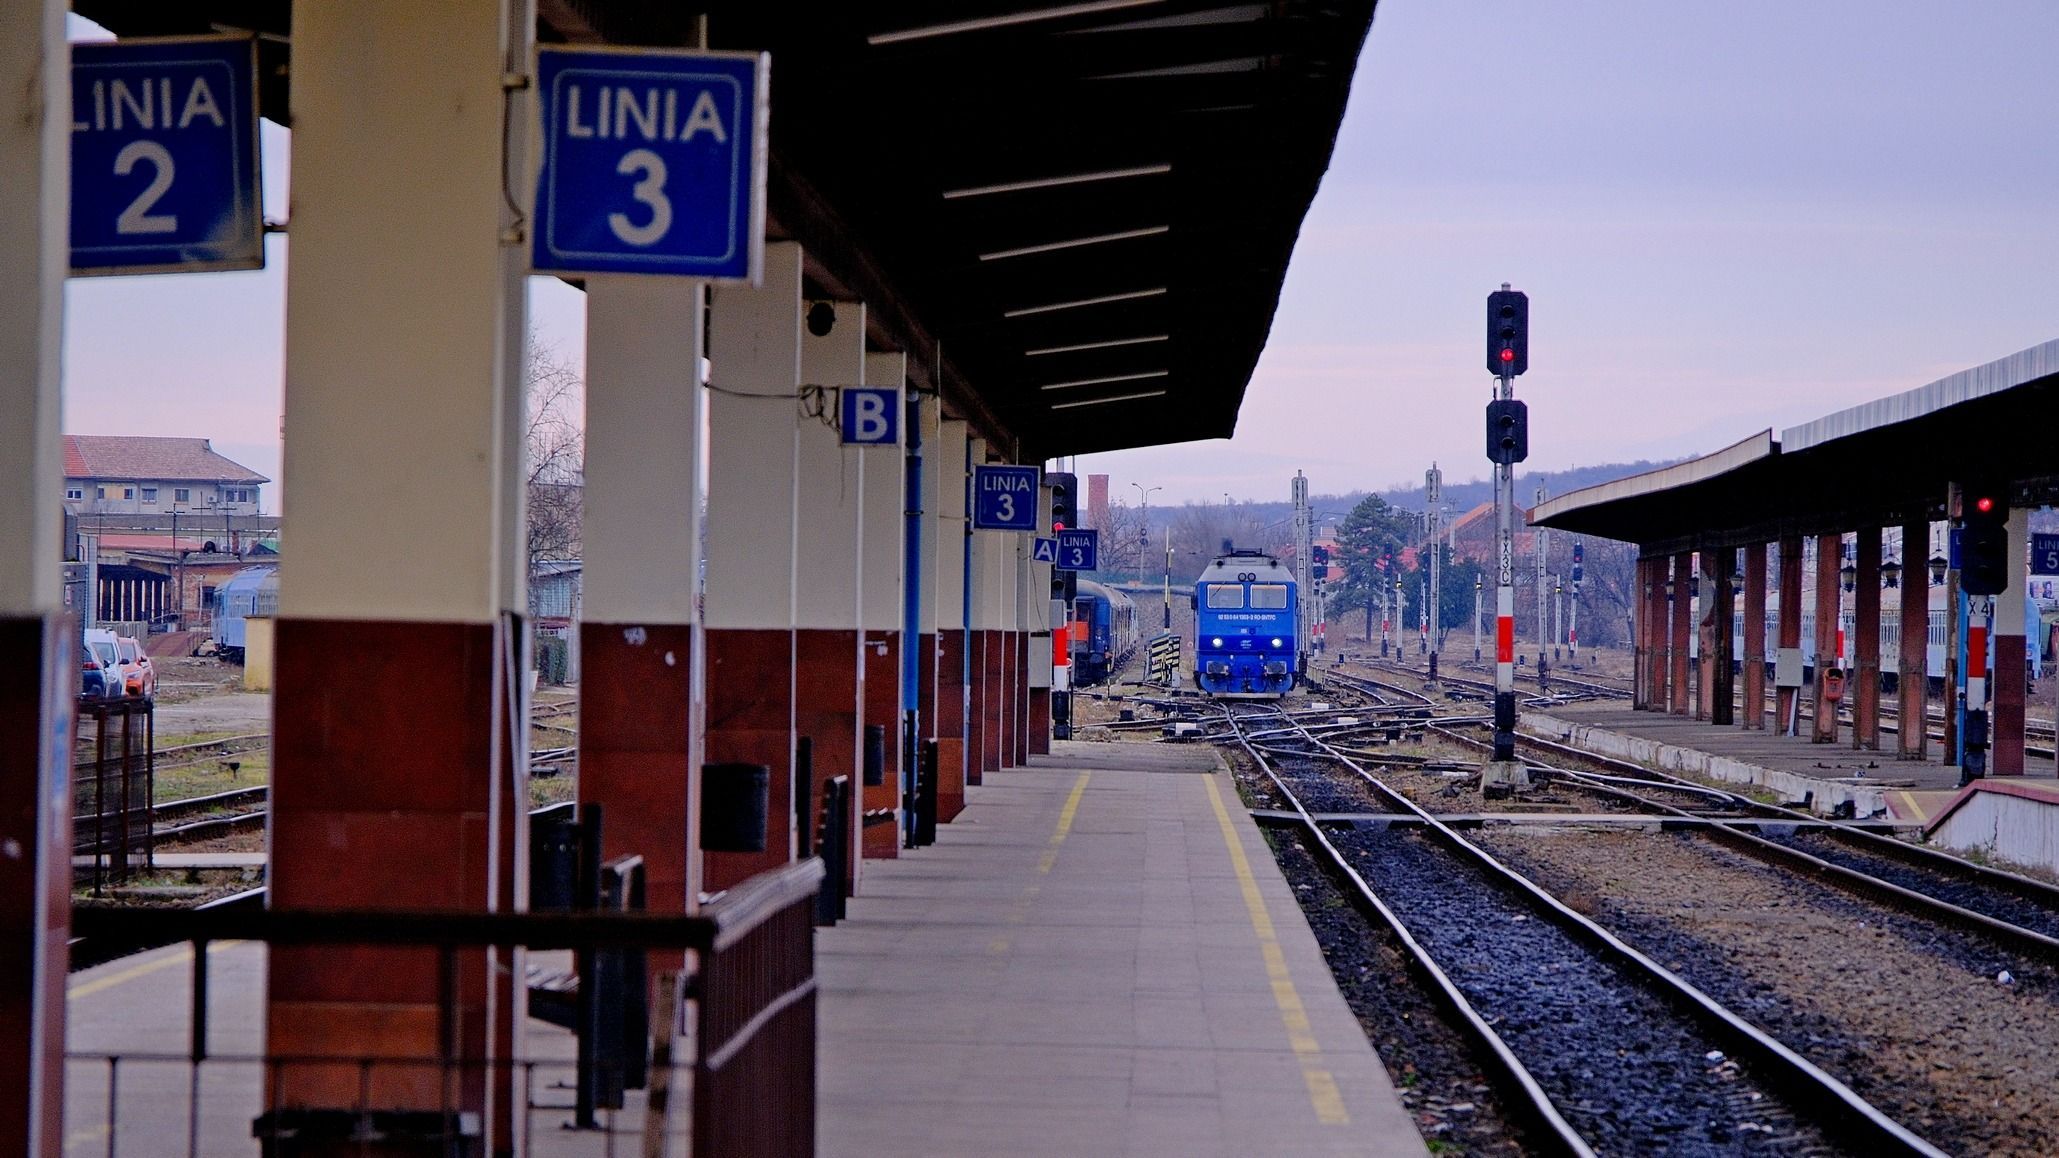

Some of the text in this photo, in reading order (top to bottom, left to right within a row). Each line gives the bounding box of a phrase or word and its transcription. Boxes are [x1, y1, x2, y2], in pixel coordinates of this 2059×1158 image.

[567, 85, 727, 143] LINIA
[113, 139, 178, 235] 2
[608, 149, 672, 246] 3
[855, 393, 887, 440] B
[984, 475, 1030, 492] LINIA
[996, 493, 1015, 521] 3
[1035, 540, 1054, 561] A
[1063, 536, 1090, 547] LINIA
[1071, 548, 1083, 566] 3
[2046, 551, 2058, 569] 5
